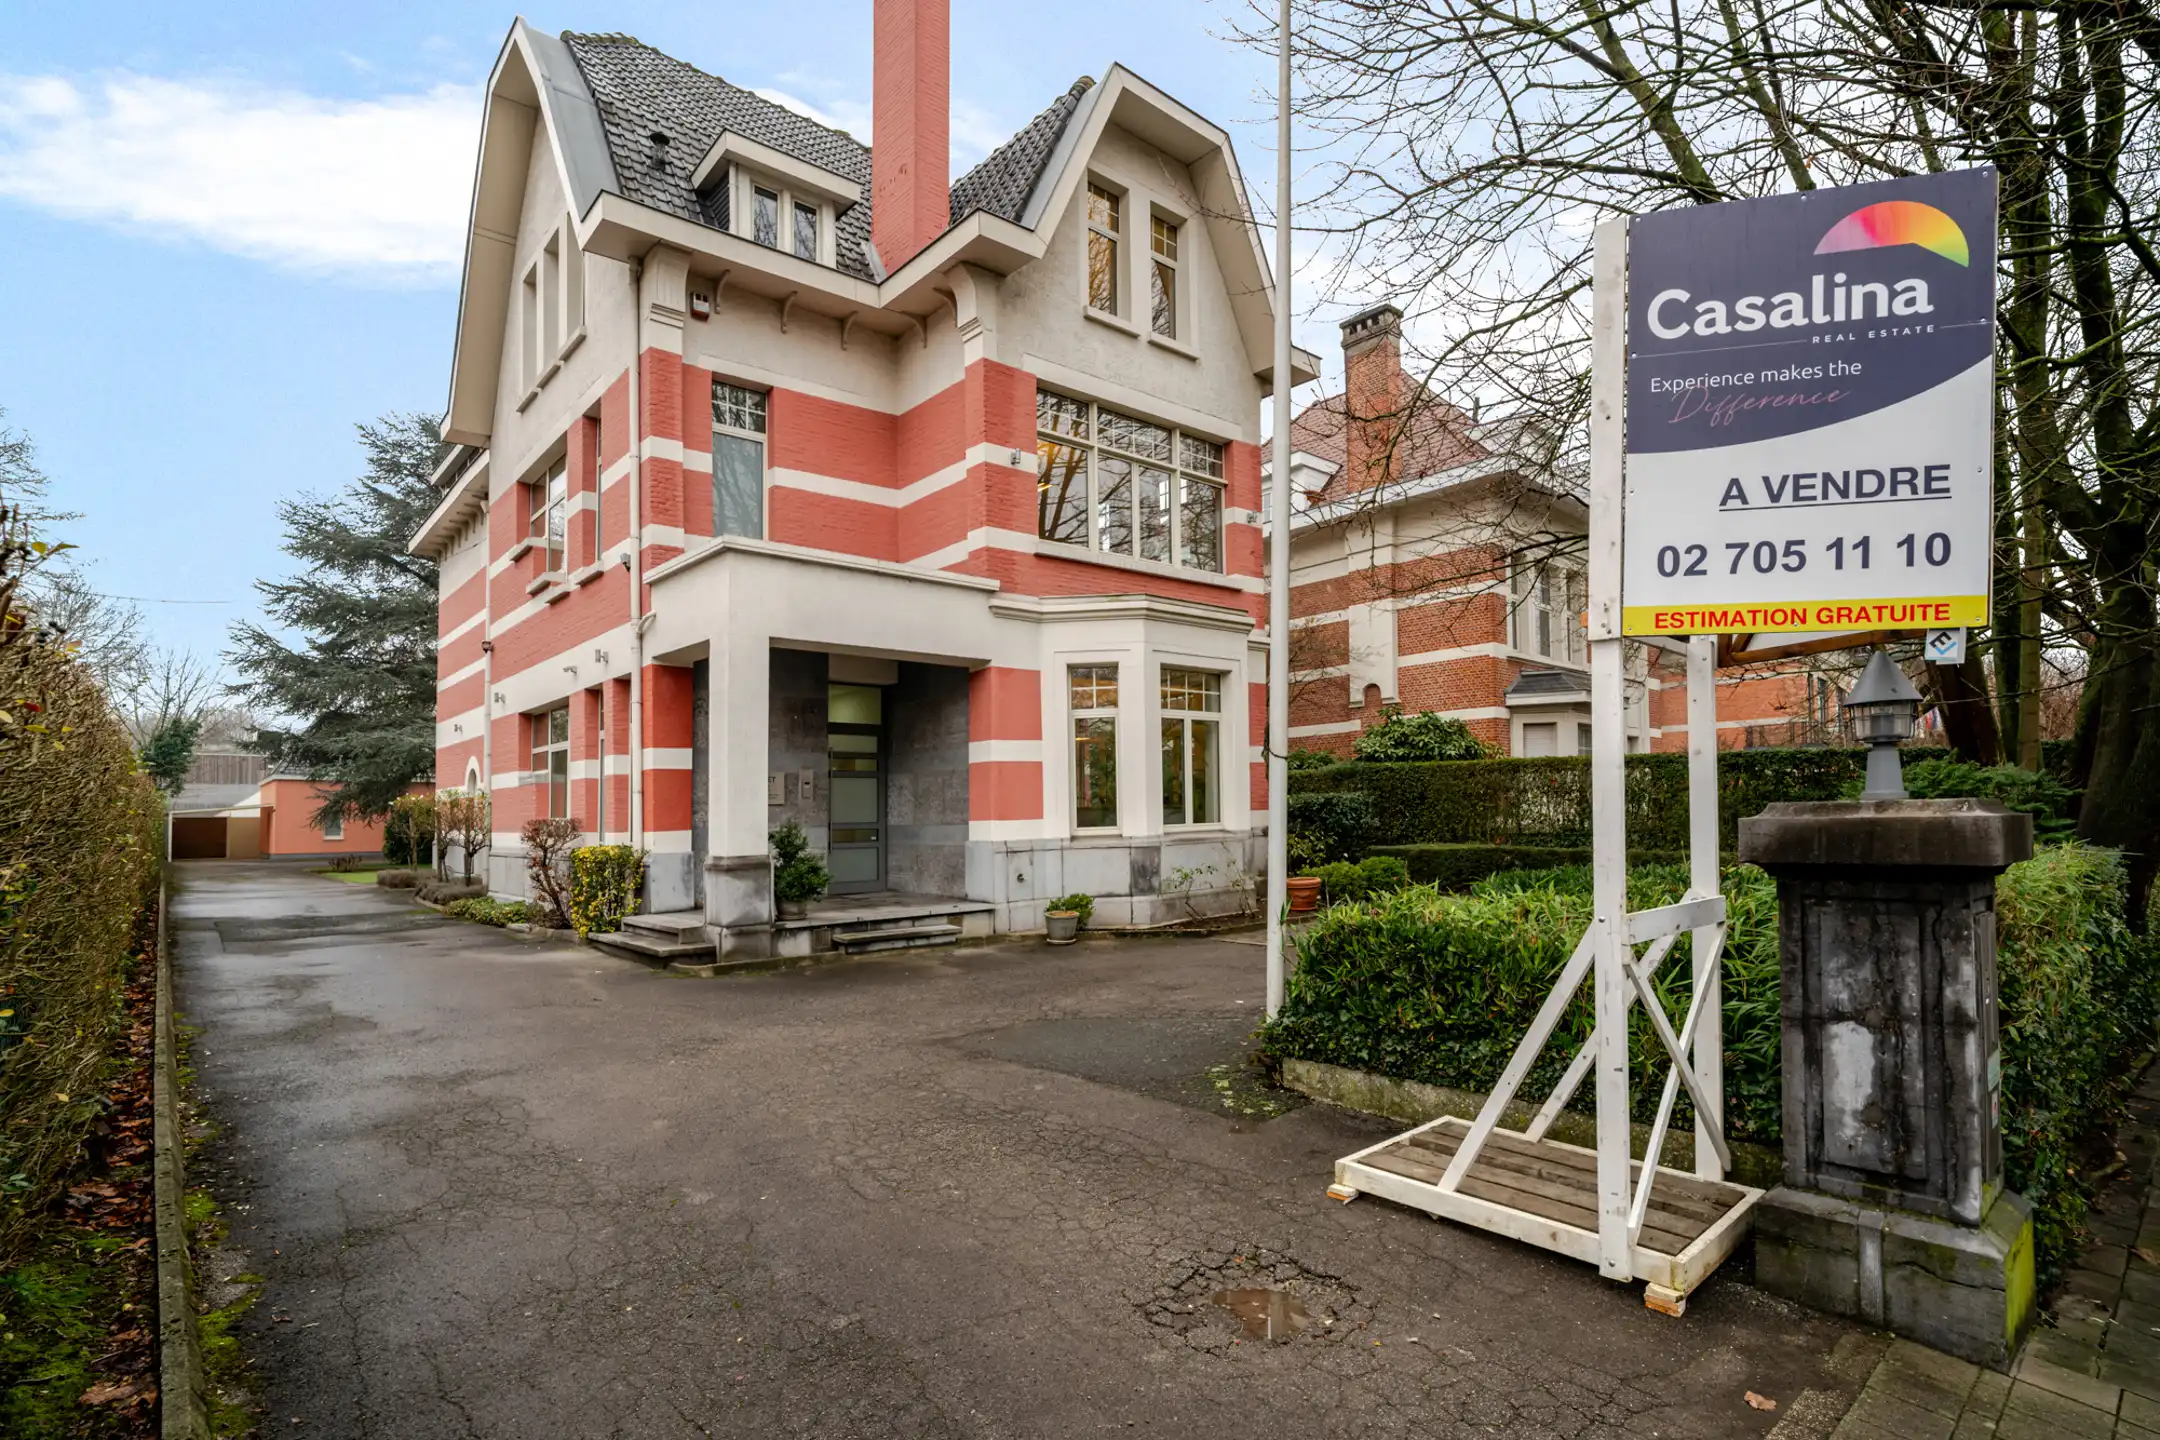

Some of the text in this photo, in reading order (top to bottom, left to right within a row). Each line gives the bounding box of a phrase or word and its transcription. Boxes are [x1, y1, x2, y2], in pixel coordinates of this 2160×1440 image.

[1647, 272, 1934, 339] Casalina
[1812, 325, 1934, 344] REAL ESTATE
[1651, 360, 1862, 393] Experience makes the
[1668, 384, 1850, 427] Difference
[1719, 464, 1951, 506] A VENDRE
[1657, 532, 1952, 578] 02 705 11 10
[1655, 603, 1951, 630] ESTIMATION GRATUITE
